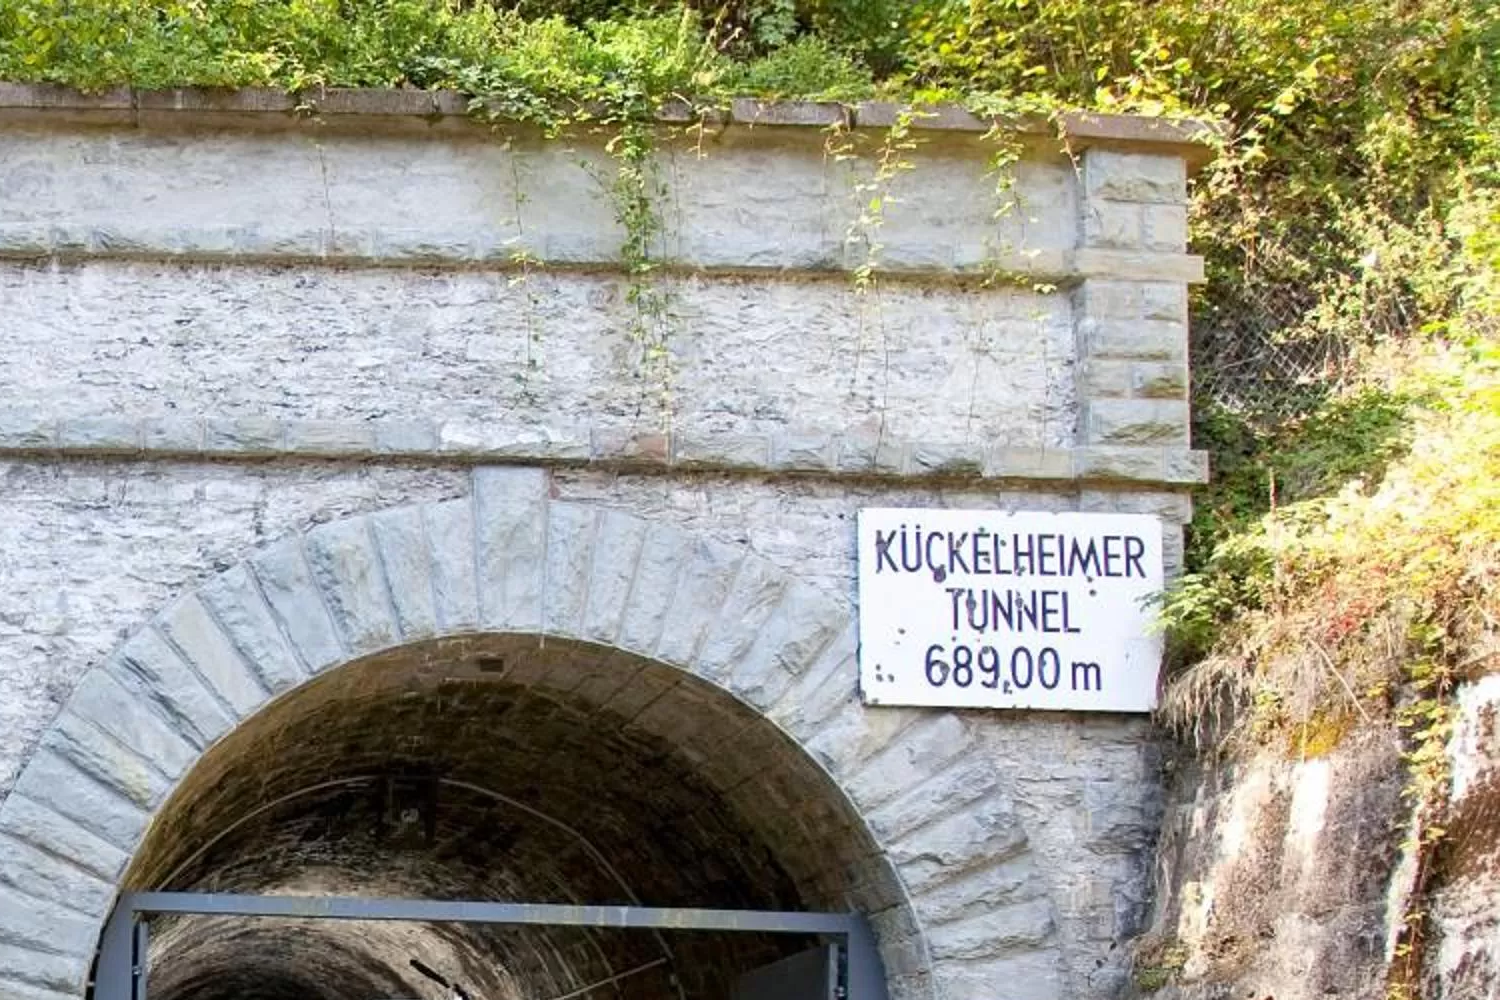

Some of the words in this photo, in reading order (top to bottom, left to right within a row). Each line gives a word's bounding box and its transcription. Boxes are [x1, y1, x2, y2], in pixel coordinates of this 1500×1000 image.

[875, 524, 1147, 578] KÜCKELHEIMER
[945, 588, 1081, 633] TUNNEL
[925, 644, 1061, 693] 689,00
[1071, 661, 1102, 690] m
